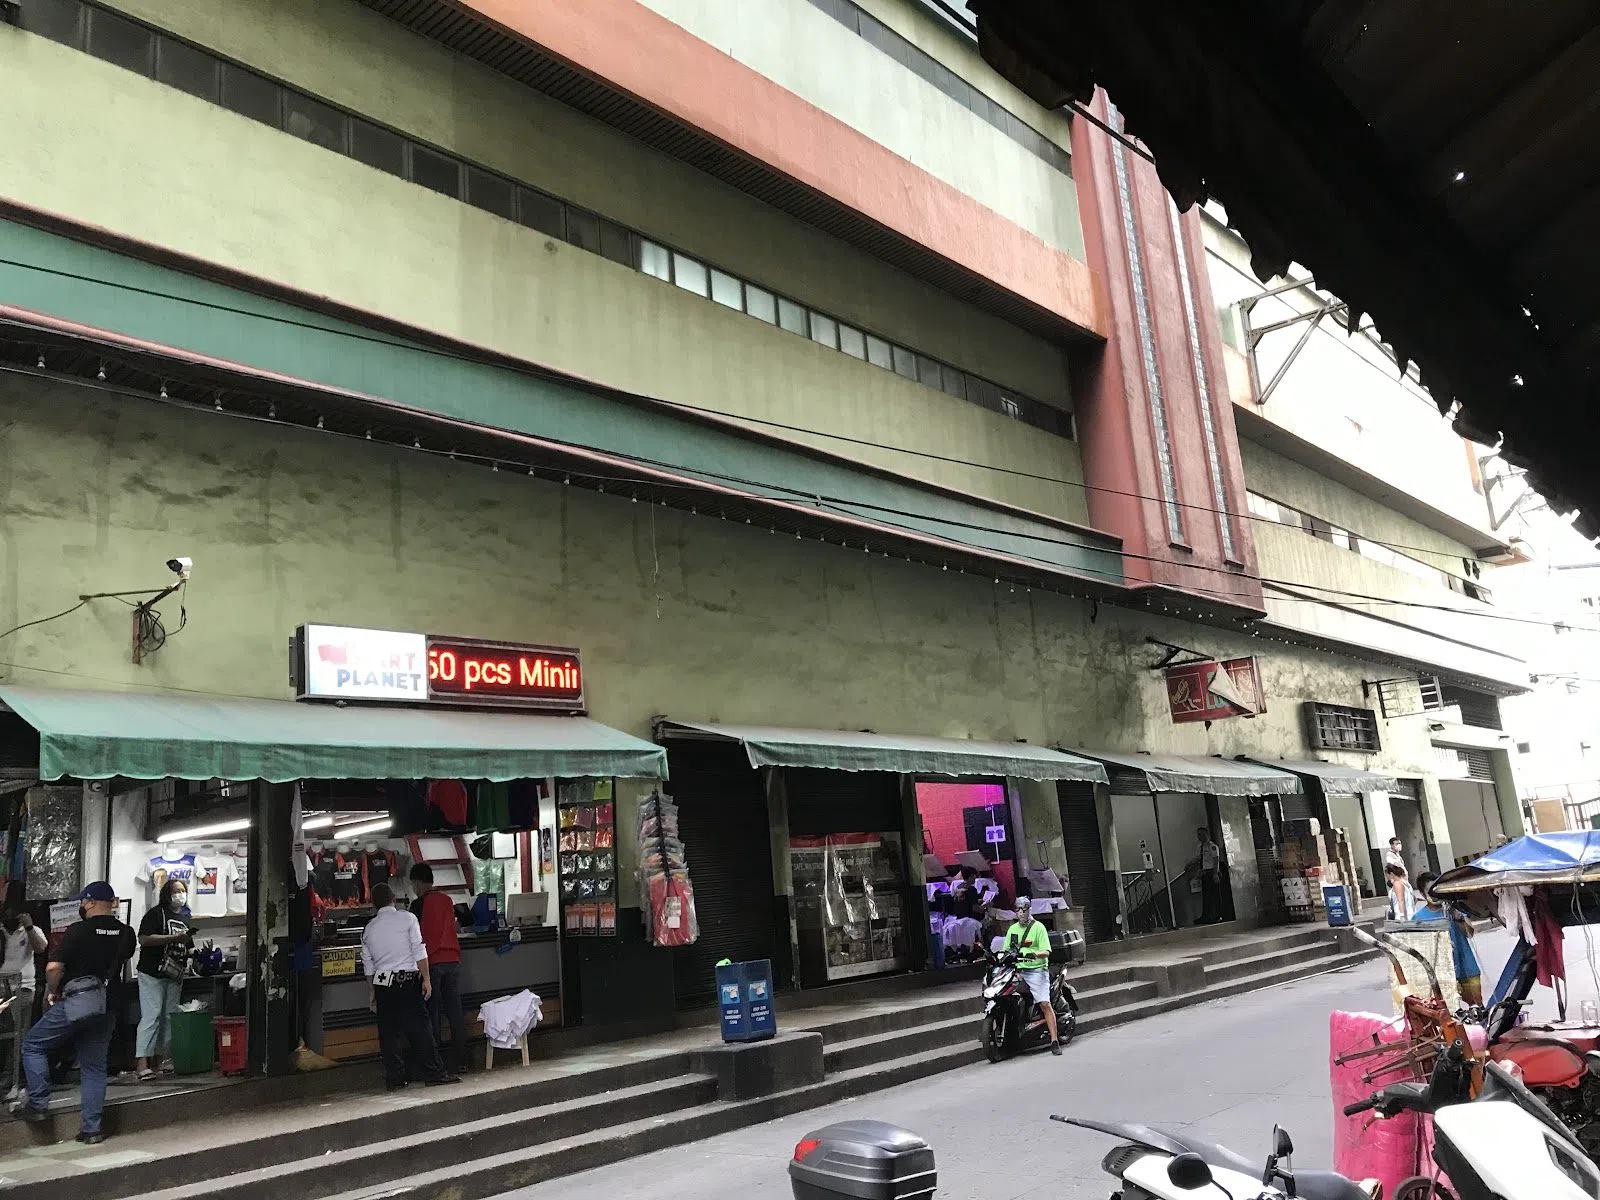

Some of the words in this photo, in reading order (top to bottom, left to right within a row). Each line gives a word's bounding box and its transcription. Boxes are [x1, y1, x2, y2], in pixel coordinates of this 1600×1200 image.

[336, 667, 422, 692] PLANET
[464, 660, 512, 690] pcs
[323, 950, 355, 961] CAUTION
